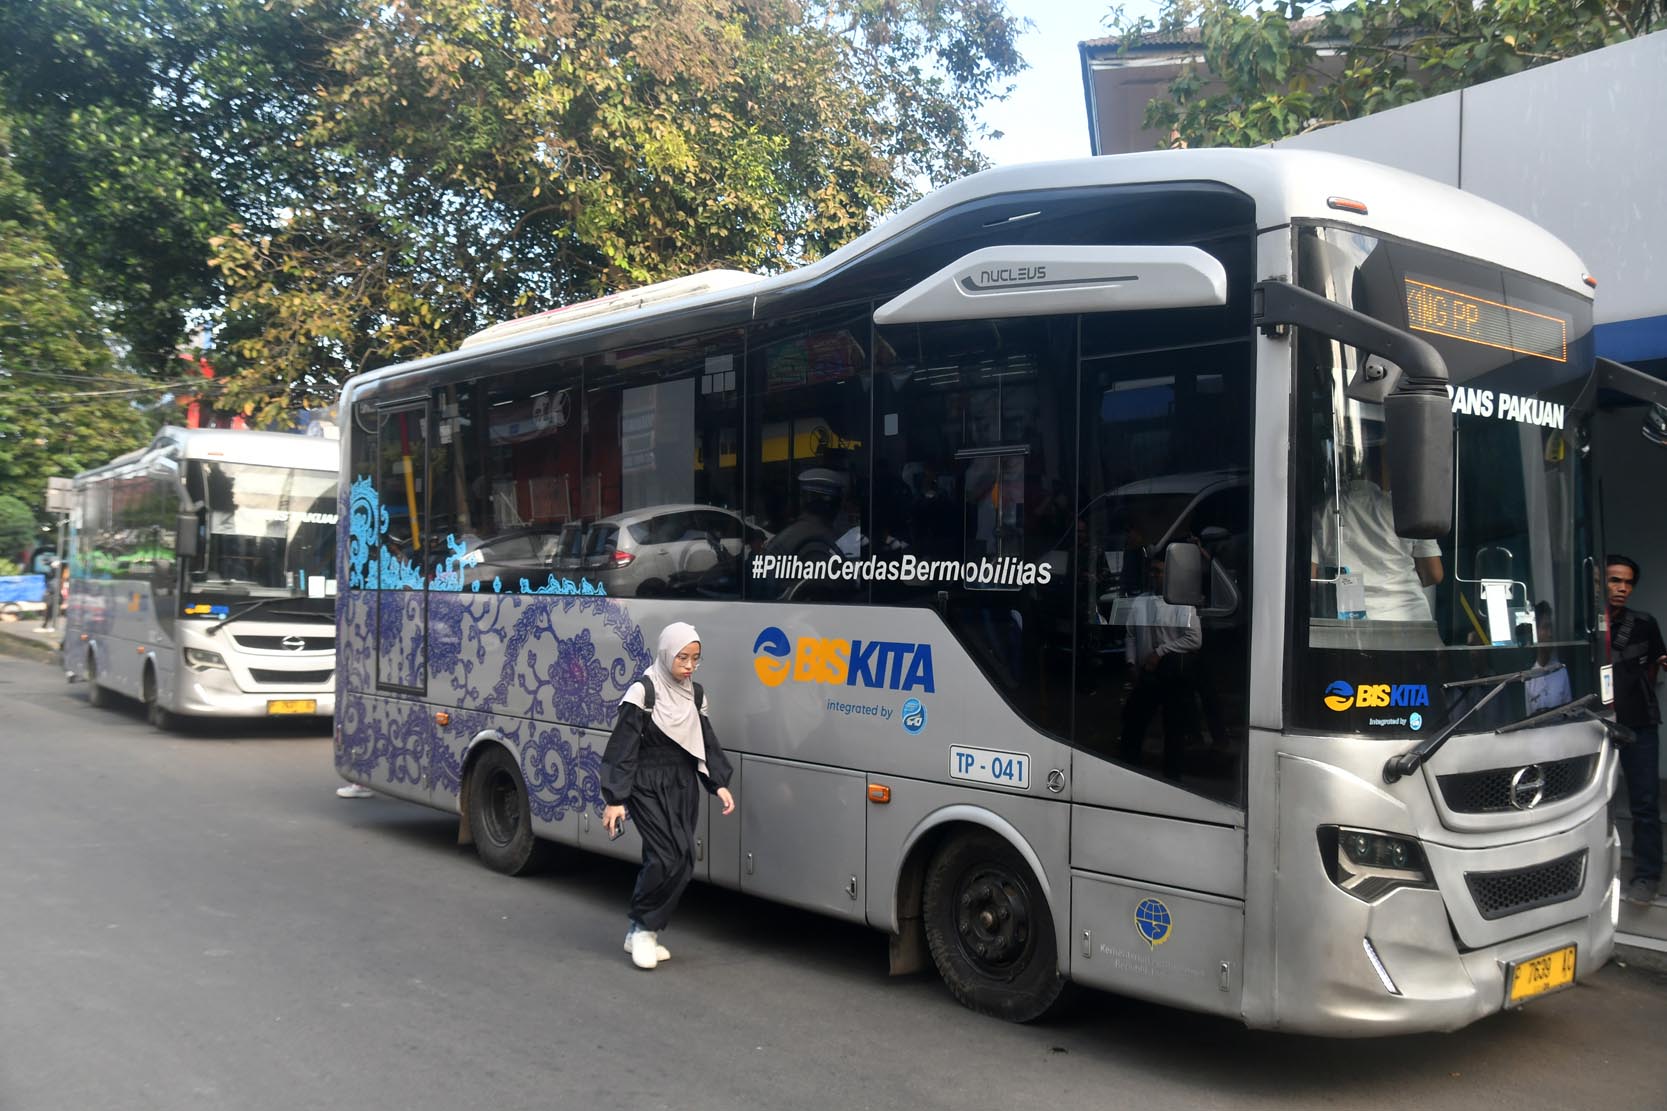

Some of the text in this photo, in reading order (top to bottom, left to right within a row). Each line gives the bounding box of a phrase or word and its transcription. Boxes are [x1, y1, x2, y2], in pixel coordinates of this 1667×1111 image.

[981, 266, 1047, 283] NUCLEUS
[1498, 392, 1565, 430] PAKUAN
[752, 555, 1052, 586] #PilihanCerdasBermobilitas
[826, 699, 878, 716] integrated
[880, 705, 894, 721] by
[956, 752, 975, 774] TP
[991, 757, 1023, 782] 041
